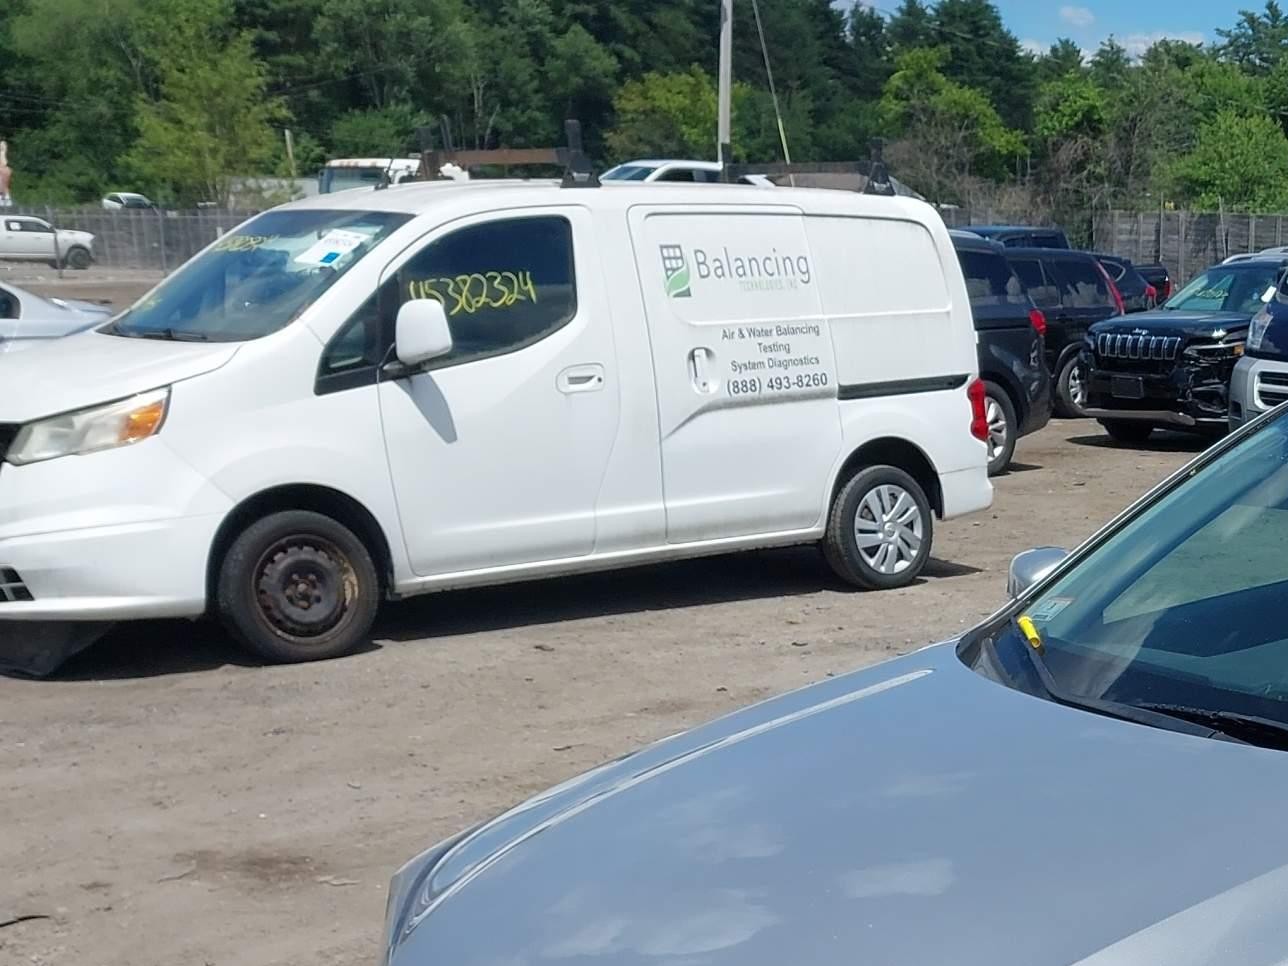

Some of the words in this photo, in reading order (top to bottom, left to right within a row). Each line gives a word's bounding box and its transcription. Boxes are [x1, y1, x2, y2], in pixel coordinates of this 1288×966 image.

[694, 247, 811, 284] Balancing
[722, 328, 735, 340] Air
[738, 328, 746, 339] &
[746, 326, 774, 339] Water
[775, 322, 820, 337] Balancing
[757, 342, 791, 354] Testing
[730, 359, 767, 374] System
[767, 355, 820, 370] Diagnostics
[727, 376, 762, 397] (888)
[767, 372, 828, 391] 493-8260
